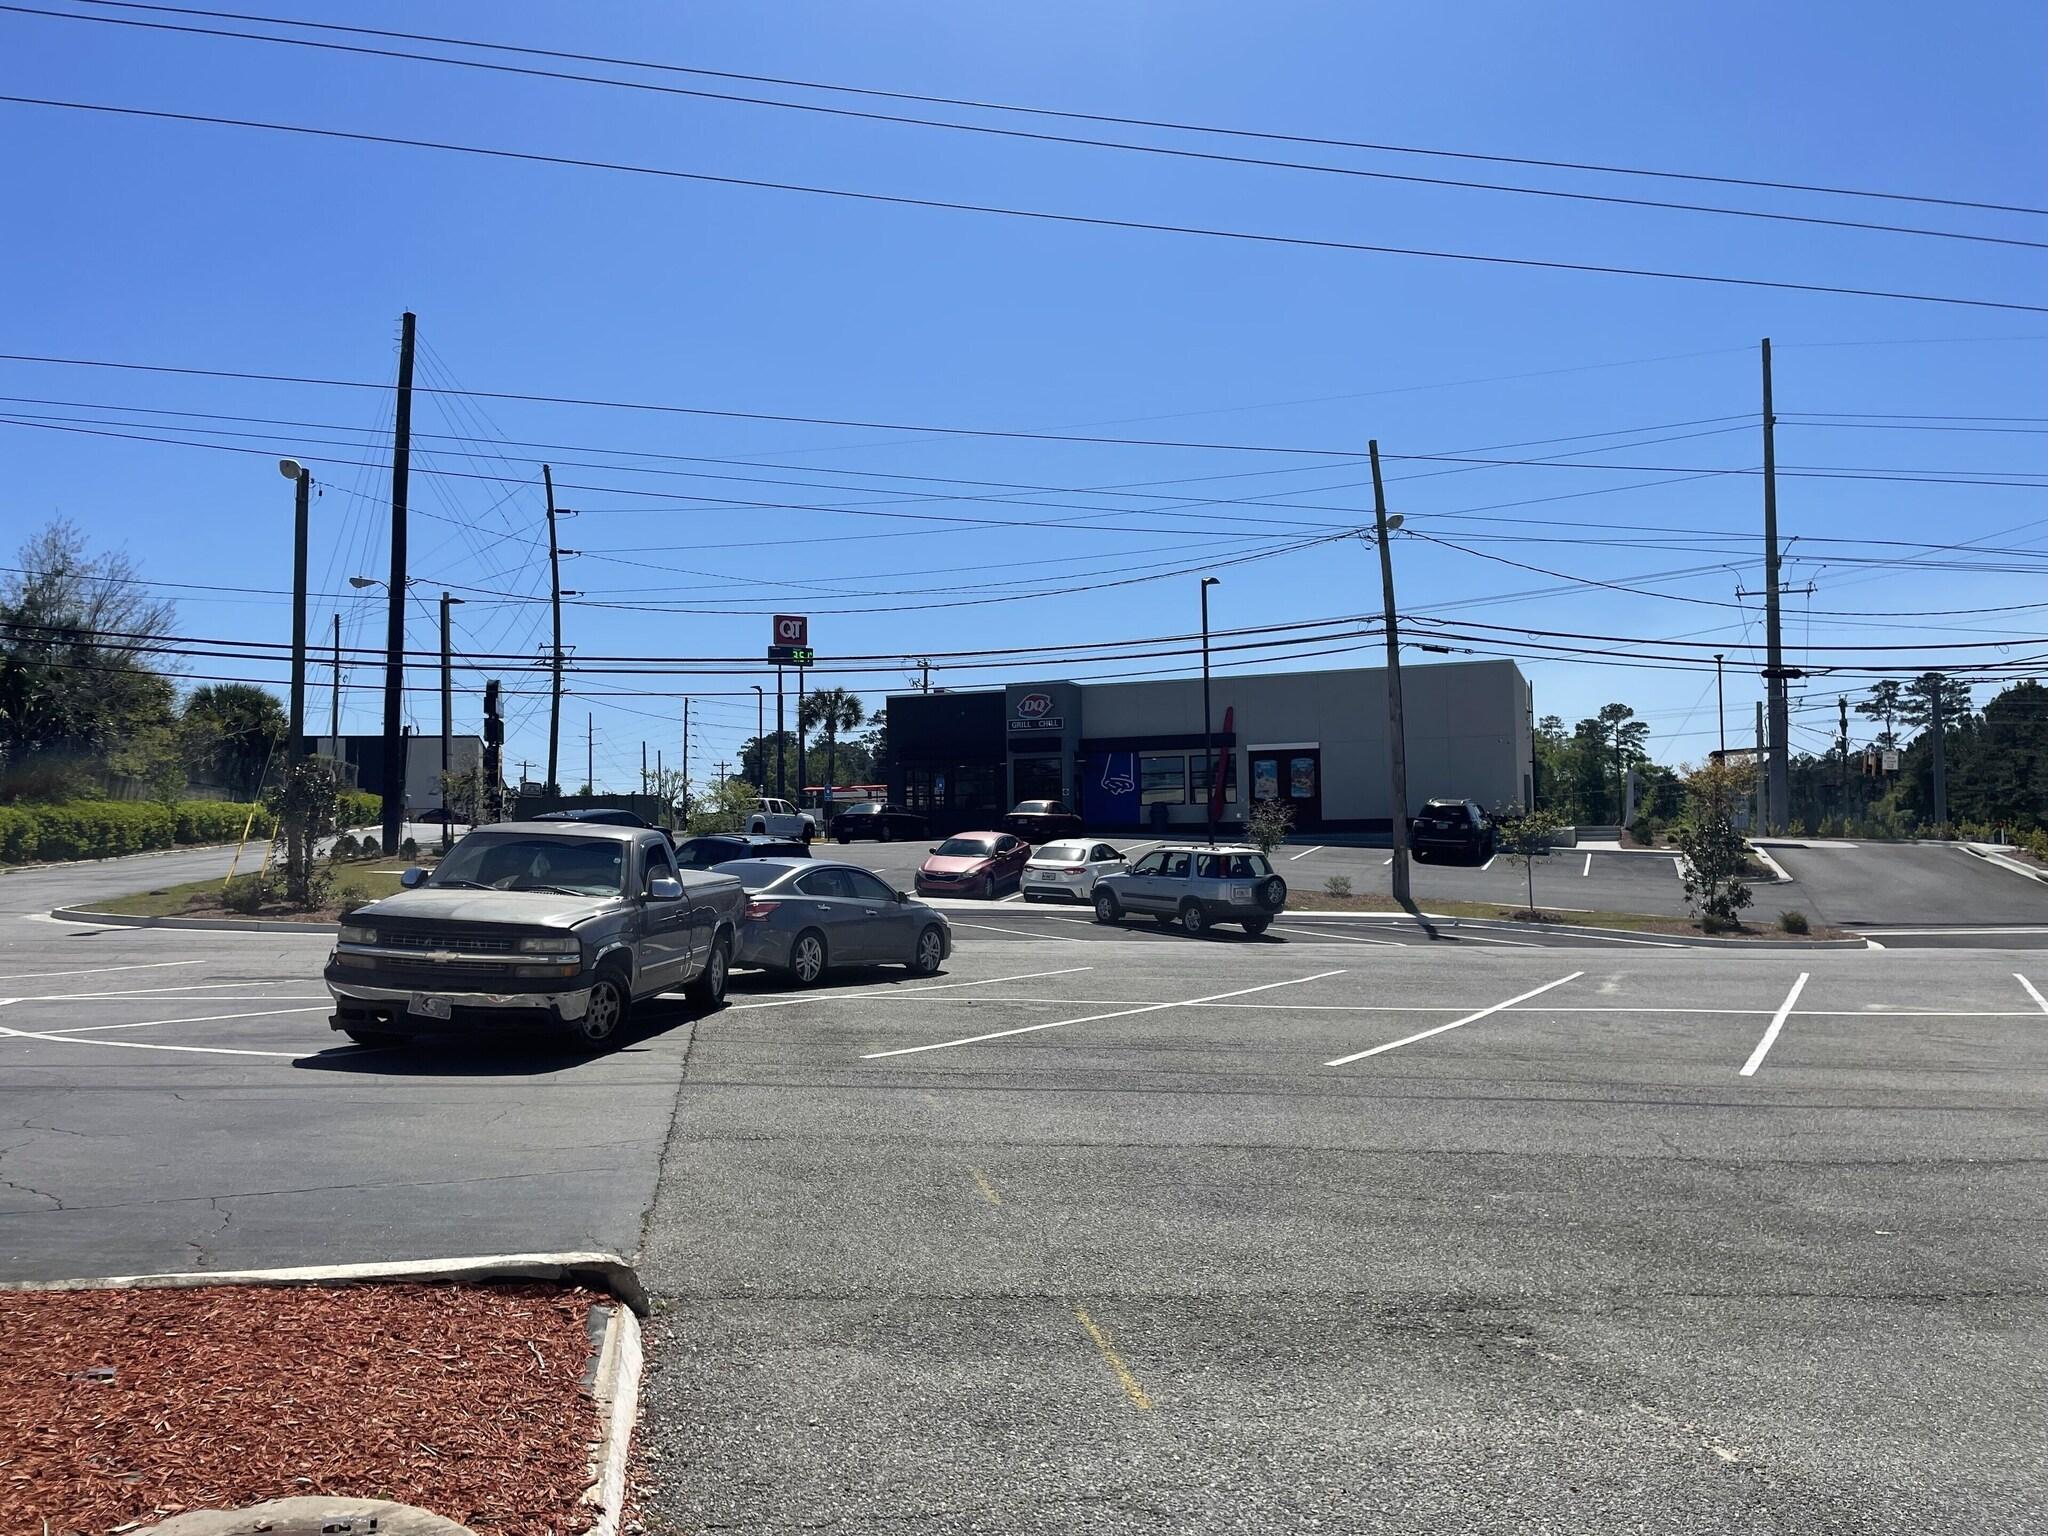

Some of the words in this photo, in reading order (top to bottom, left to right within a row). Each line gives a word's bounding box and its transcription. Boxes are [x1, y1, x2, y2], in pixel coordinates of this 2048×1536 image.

[780, 620, 802, 639] QT
[1024, 700, 1045, 712] DQ
[1038, 720, 1058, 728] CHILL
